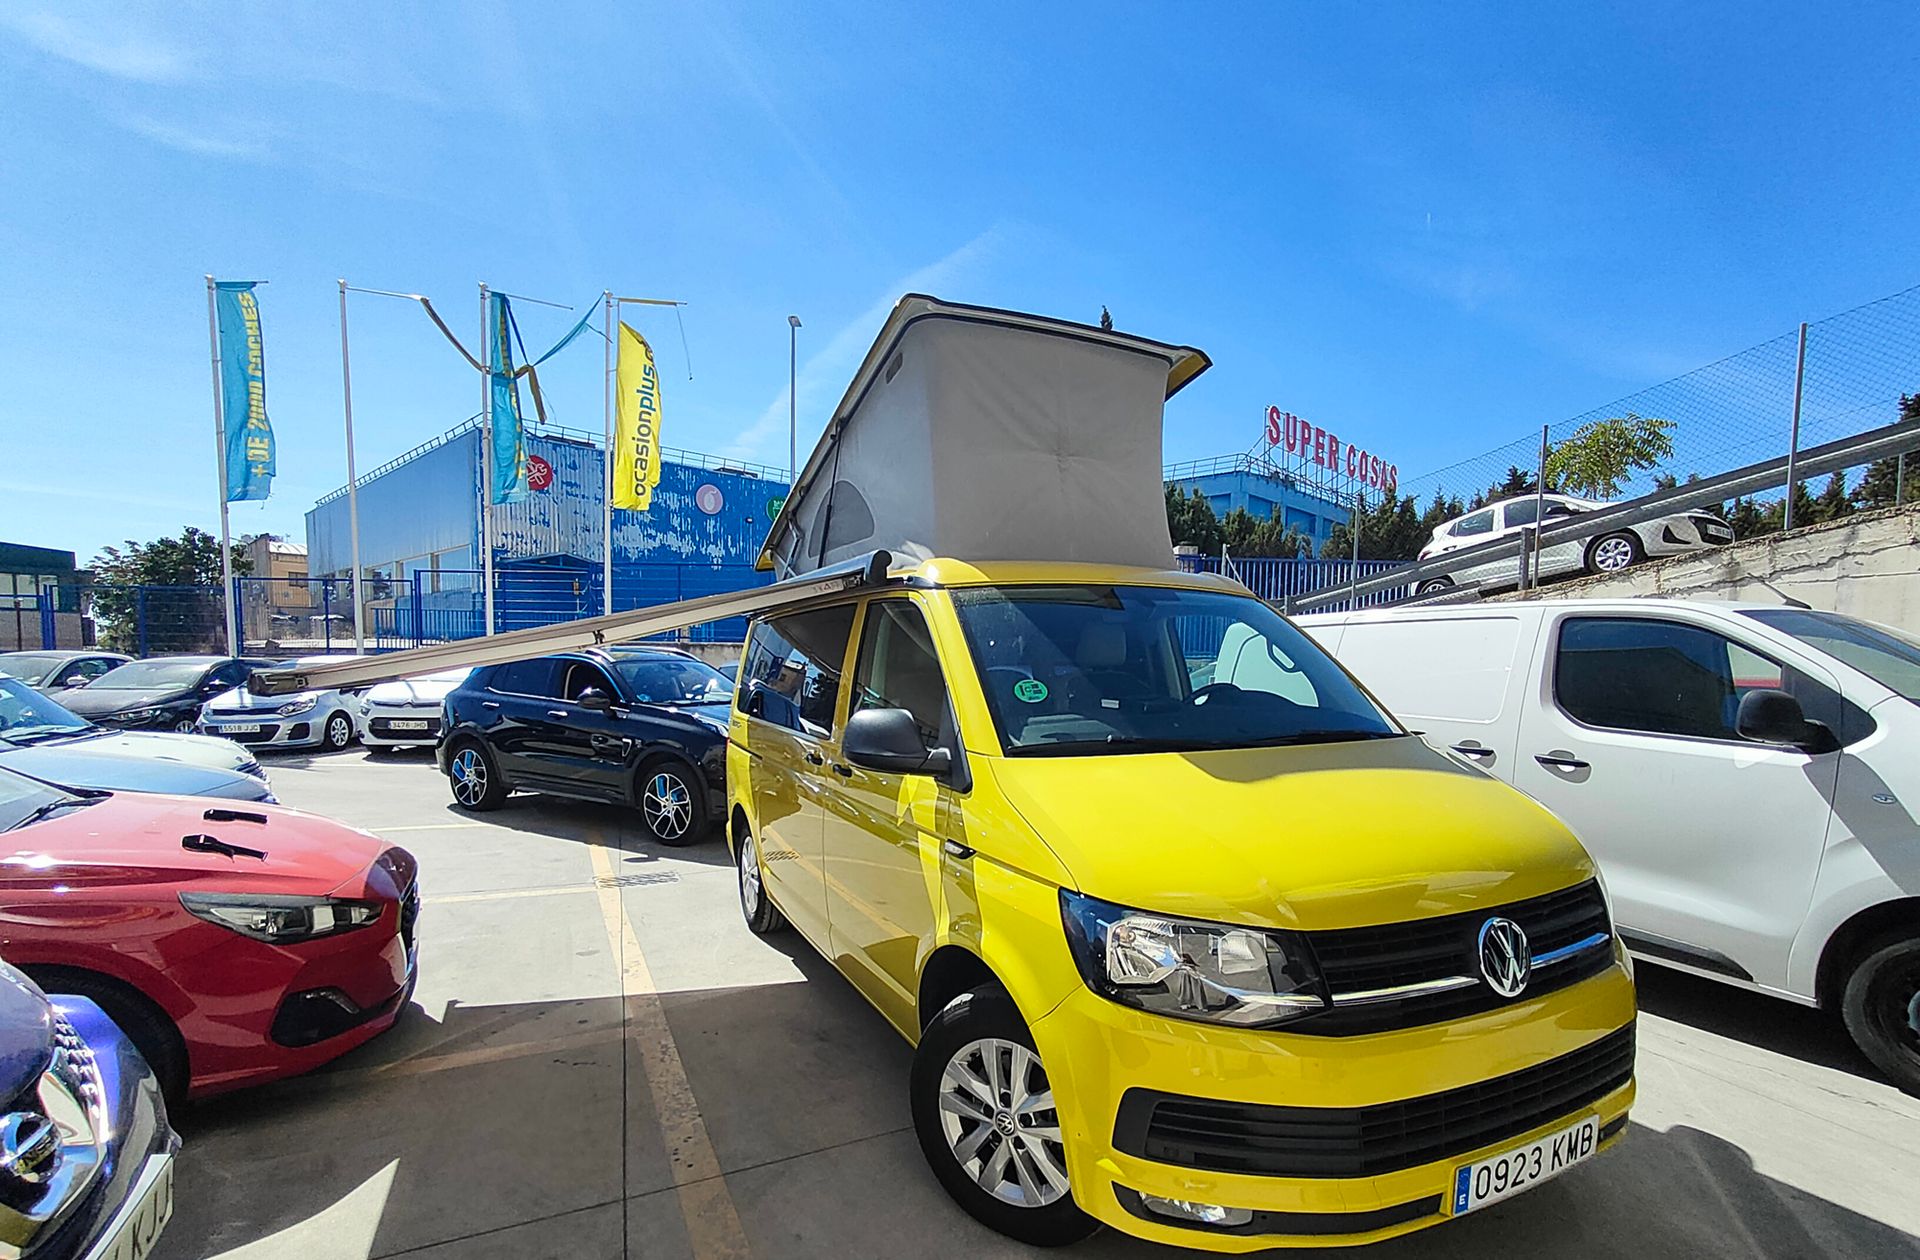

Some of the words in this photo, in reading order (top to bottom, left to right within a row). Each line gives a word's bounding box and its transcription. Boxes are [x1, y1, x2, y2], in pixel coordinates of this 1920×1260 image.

[238, 291, 263, 376] COCHES
[247, 436, 270, 462] DE
[1268, 405, 1339, 472] SUPER
[1346, 444, 1398, 494] COSAS
[1458, 1194, 1467, 1206] E
[1475, 1146, 1543, 1200] 0923
[1551, 1123, 1593, 1172] KMB
